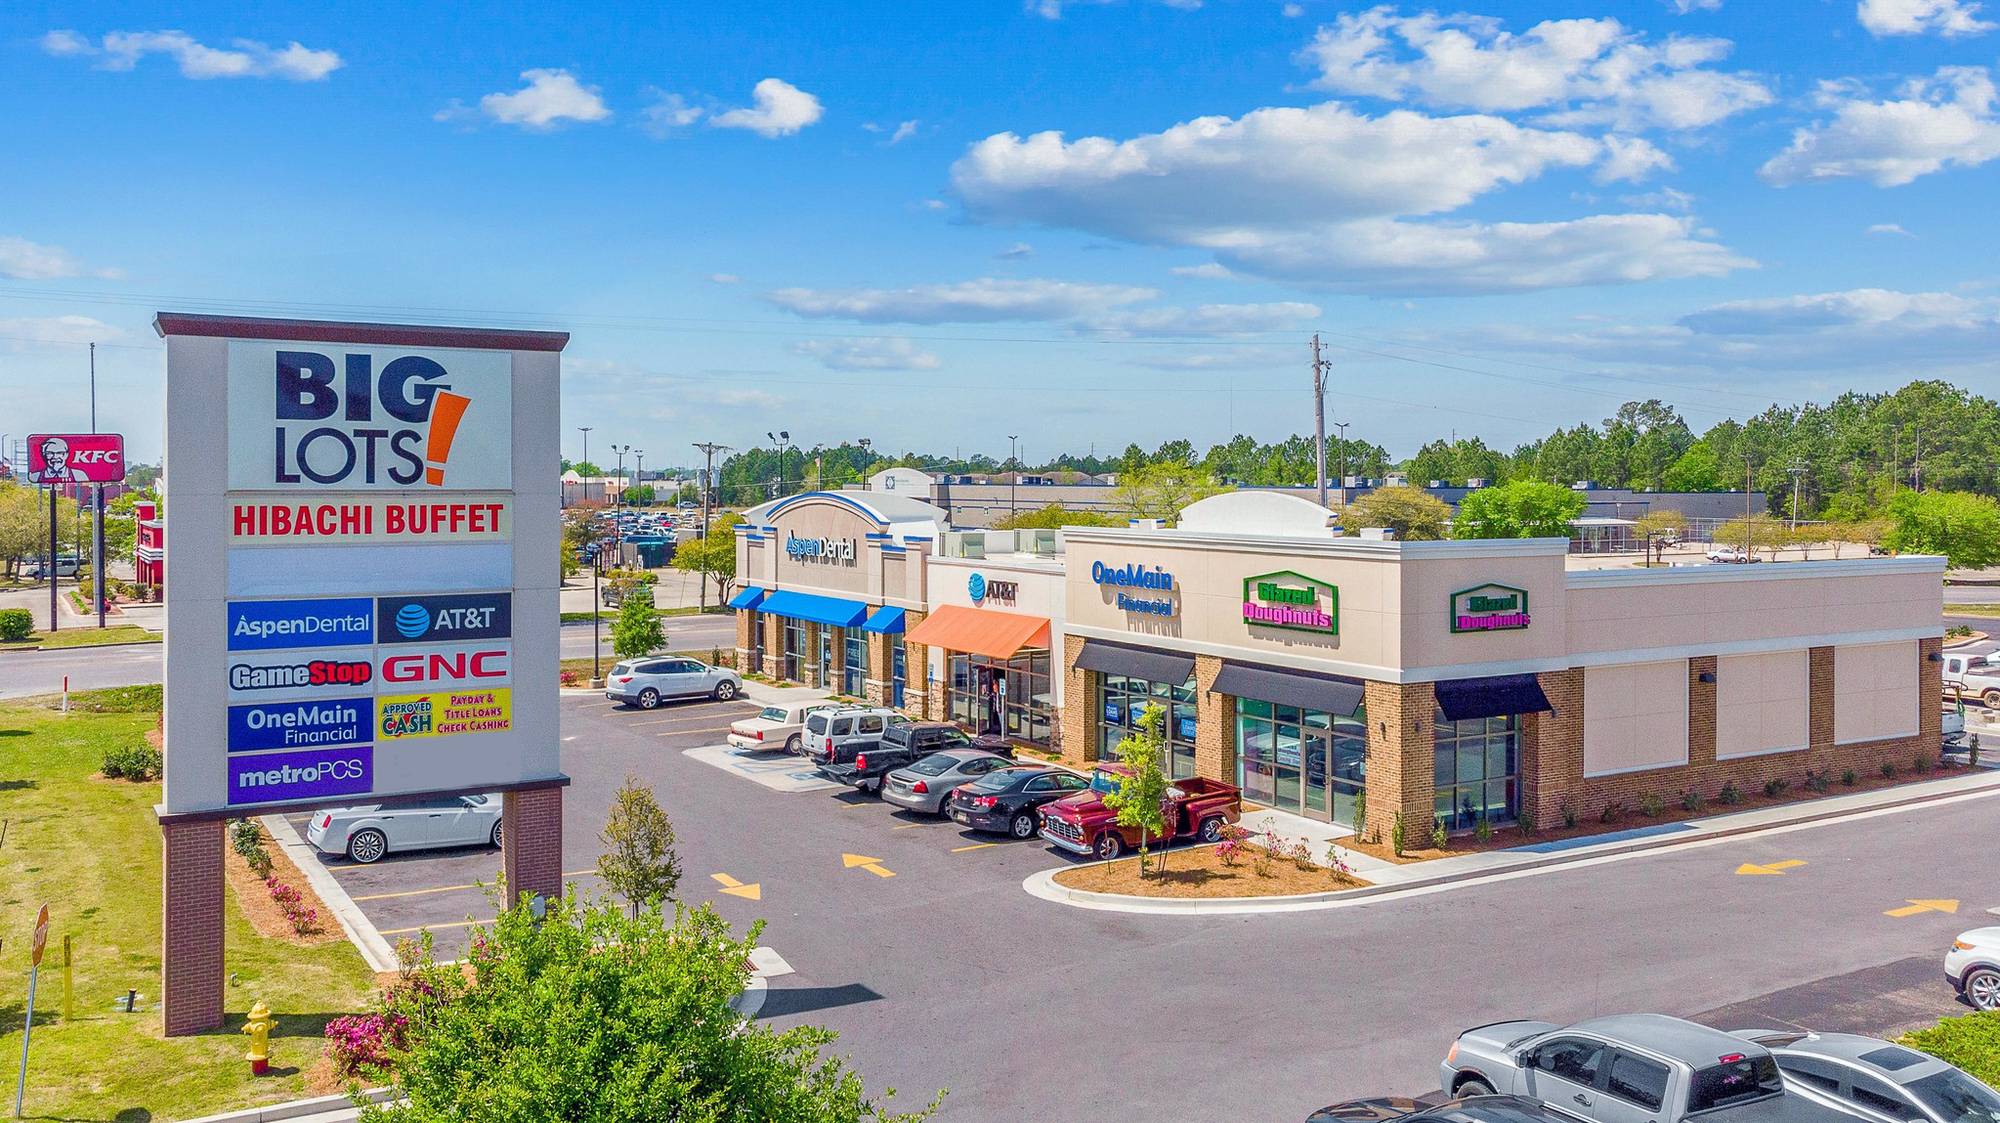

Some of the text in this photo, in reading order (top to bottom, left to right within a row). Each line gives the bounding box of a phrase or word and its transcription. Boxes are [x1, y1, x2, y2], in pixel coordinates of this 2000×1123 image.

[276, 351, 452, 423] BIG
[72, 450, 119, 463] KFC
[233, 503, 504, 536] HIBACHI BUFFET
[1092, 560, 1172, 590] OneMain
[986, 580, 1018, 600] AT&T
[1257, 582, 1315, 605] Glazed
[1116, 592, 1172, 616] Financial
[1243, 602, 1333, 627] Doughnuts
[1470, 593, 1517, 612] Glazed
[434, 607, 496, 631] AT&T
[1456, 612, 1531, 631] Doughnuts
[229, 660, 373, 690] GameStop
[382, 651, 507, 683] GNC
[382, 702, 432, 715] APPROVED
[487, 693, 494, 704] &
[246, 705, 357, 729] OneMain
[382, 713, 432, 736] CASH
[285, 725, 357, 744] Financial
[239, 759, 363, 788] metroPCS
